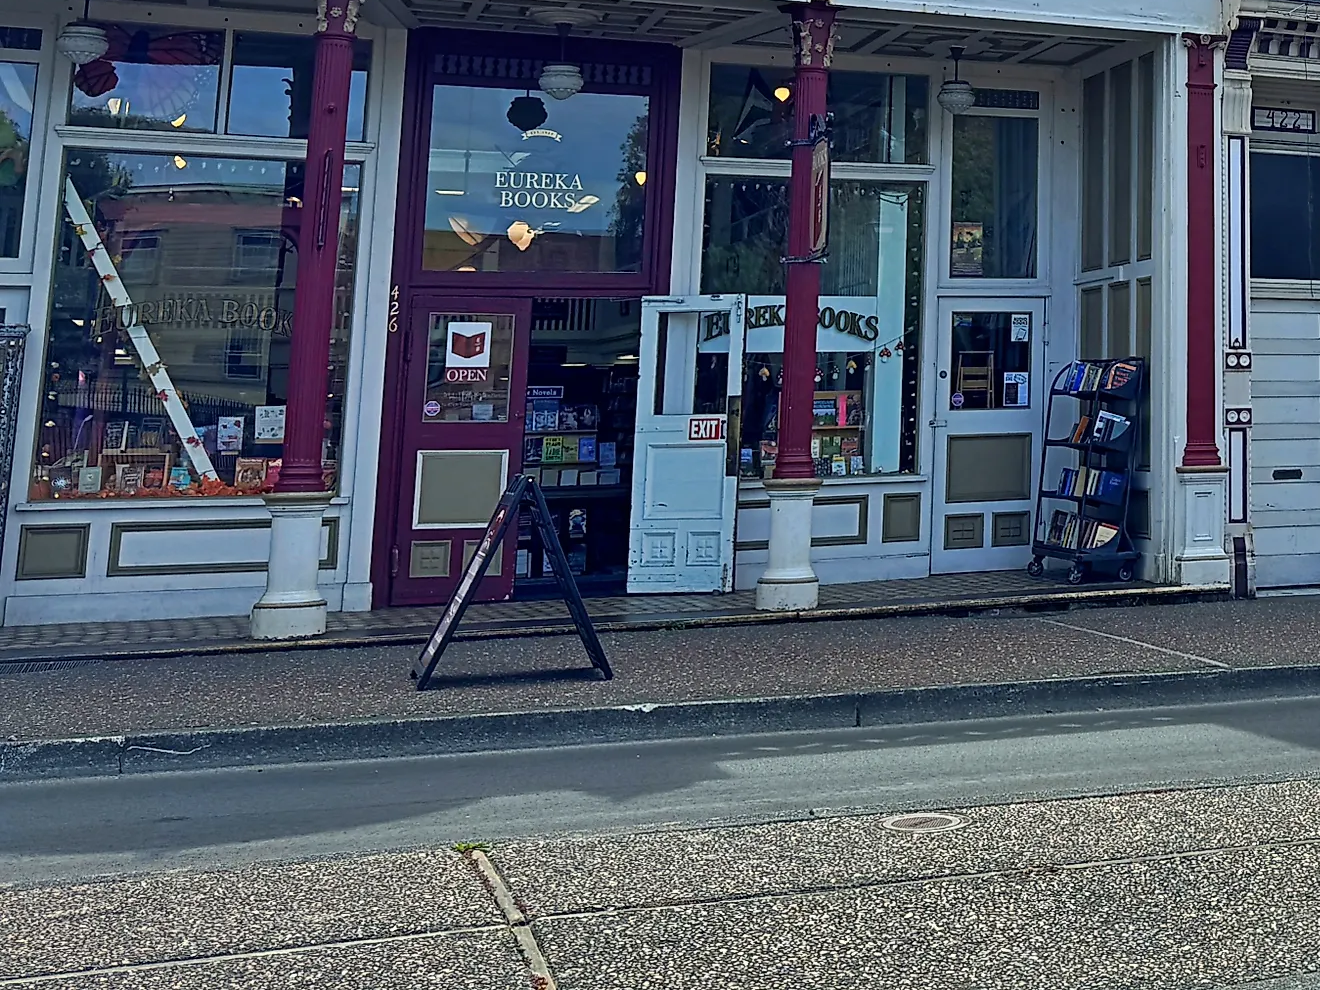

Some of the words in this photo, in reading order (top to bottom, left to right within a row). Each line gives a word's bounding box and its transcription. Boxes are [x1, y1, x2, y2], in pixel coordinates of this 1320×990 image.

[1266, 111, 1300, 128] 422
[494, 171, 583, 191] EUREKA
[500, 191, 576, 209] BOOKS
[91, 298, 213, 336] EUREKA
[219, 298, 293, 337] BOOK
[388, 285, 400, 333] 426
[816, 306, 880, 341] OOKS
[446, 369, 488, 382] OPEN
[690, 420, 718, 438] EXIT
